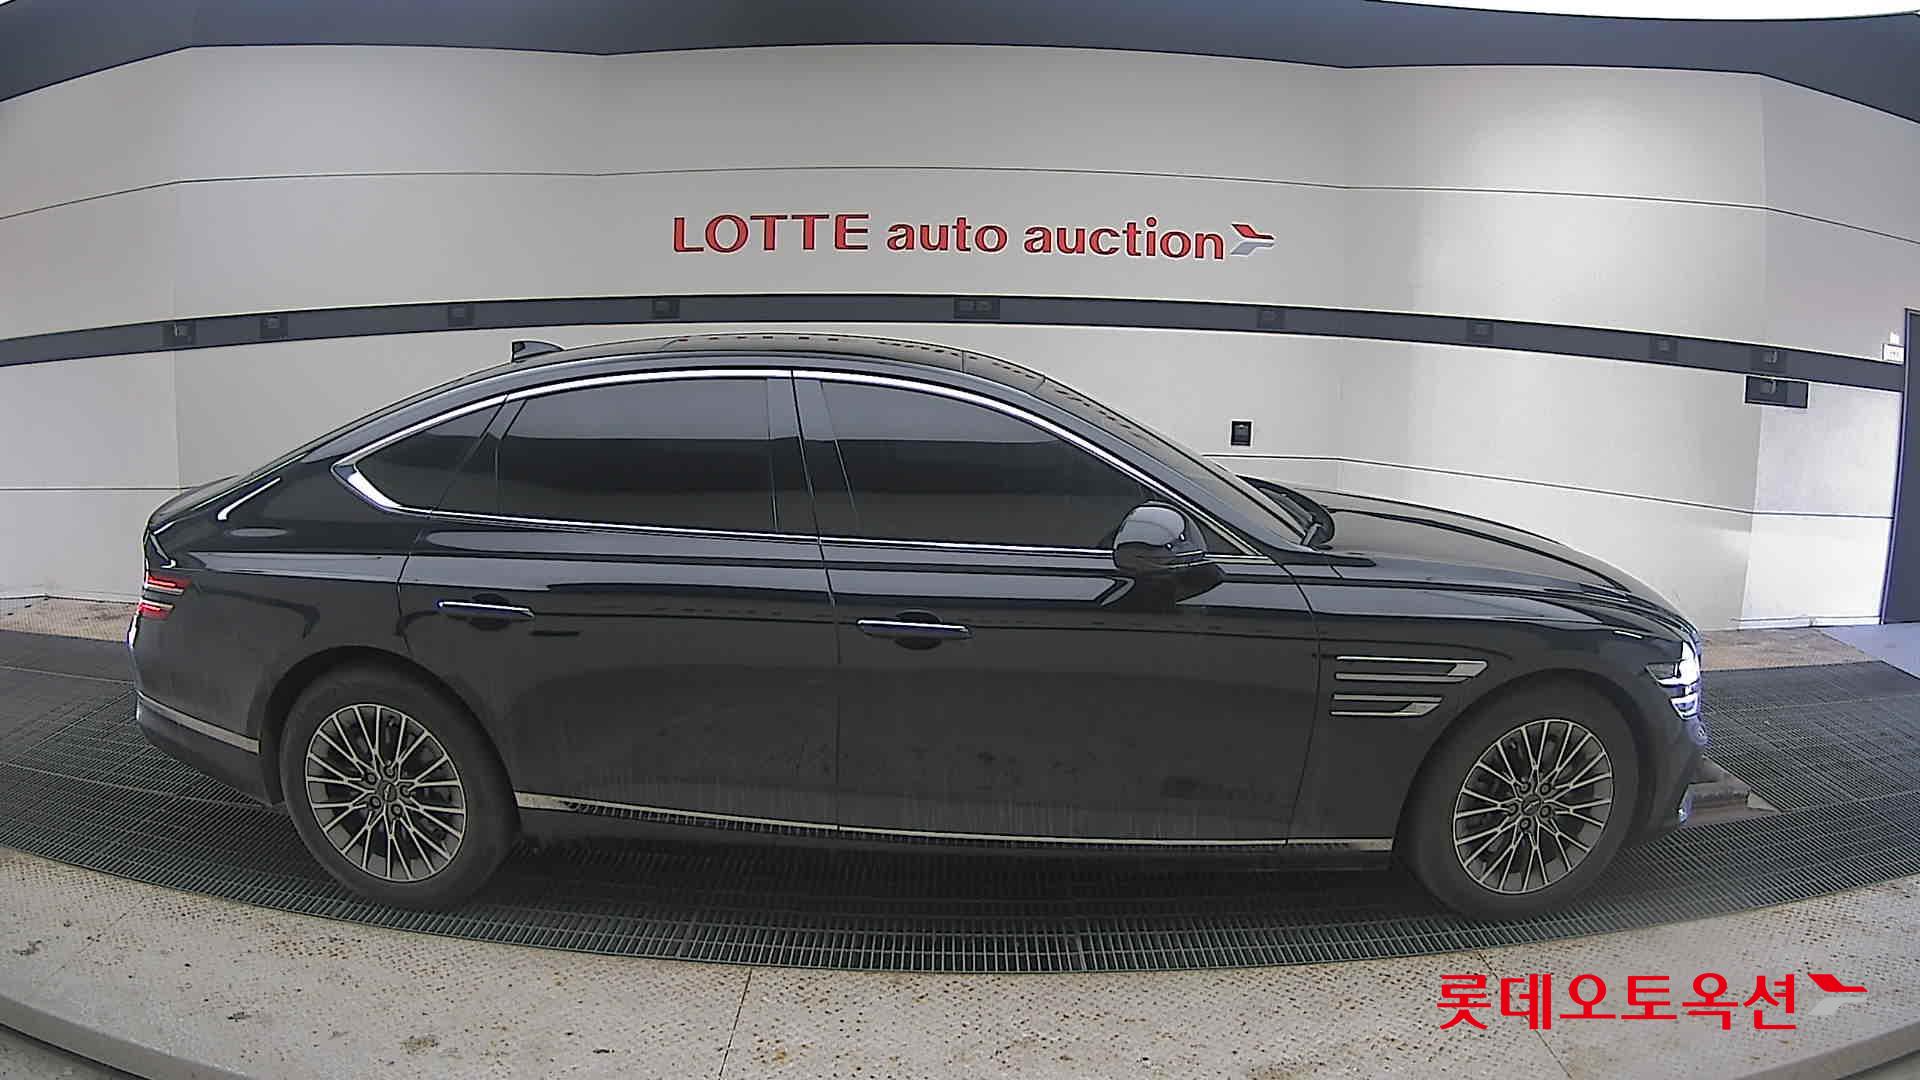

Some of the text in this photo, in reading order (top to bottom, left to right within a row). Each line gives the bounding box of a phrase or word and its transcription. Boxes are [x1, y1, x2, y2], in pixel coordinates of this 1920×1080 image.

[671, 213, 1226, 261] LOTTE auto auction
